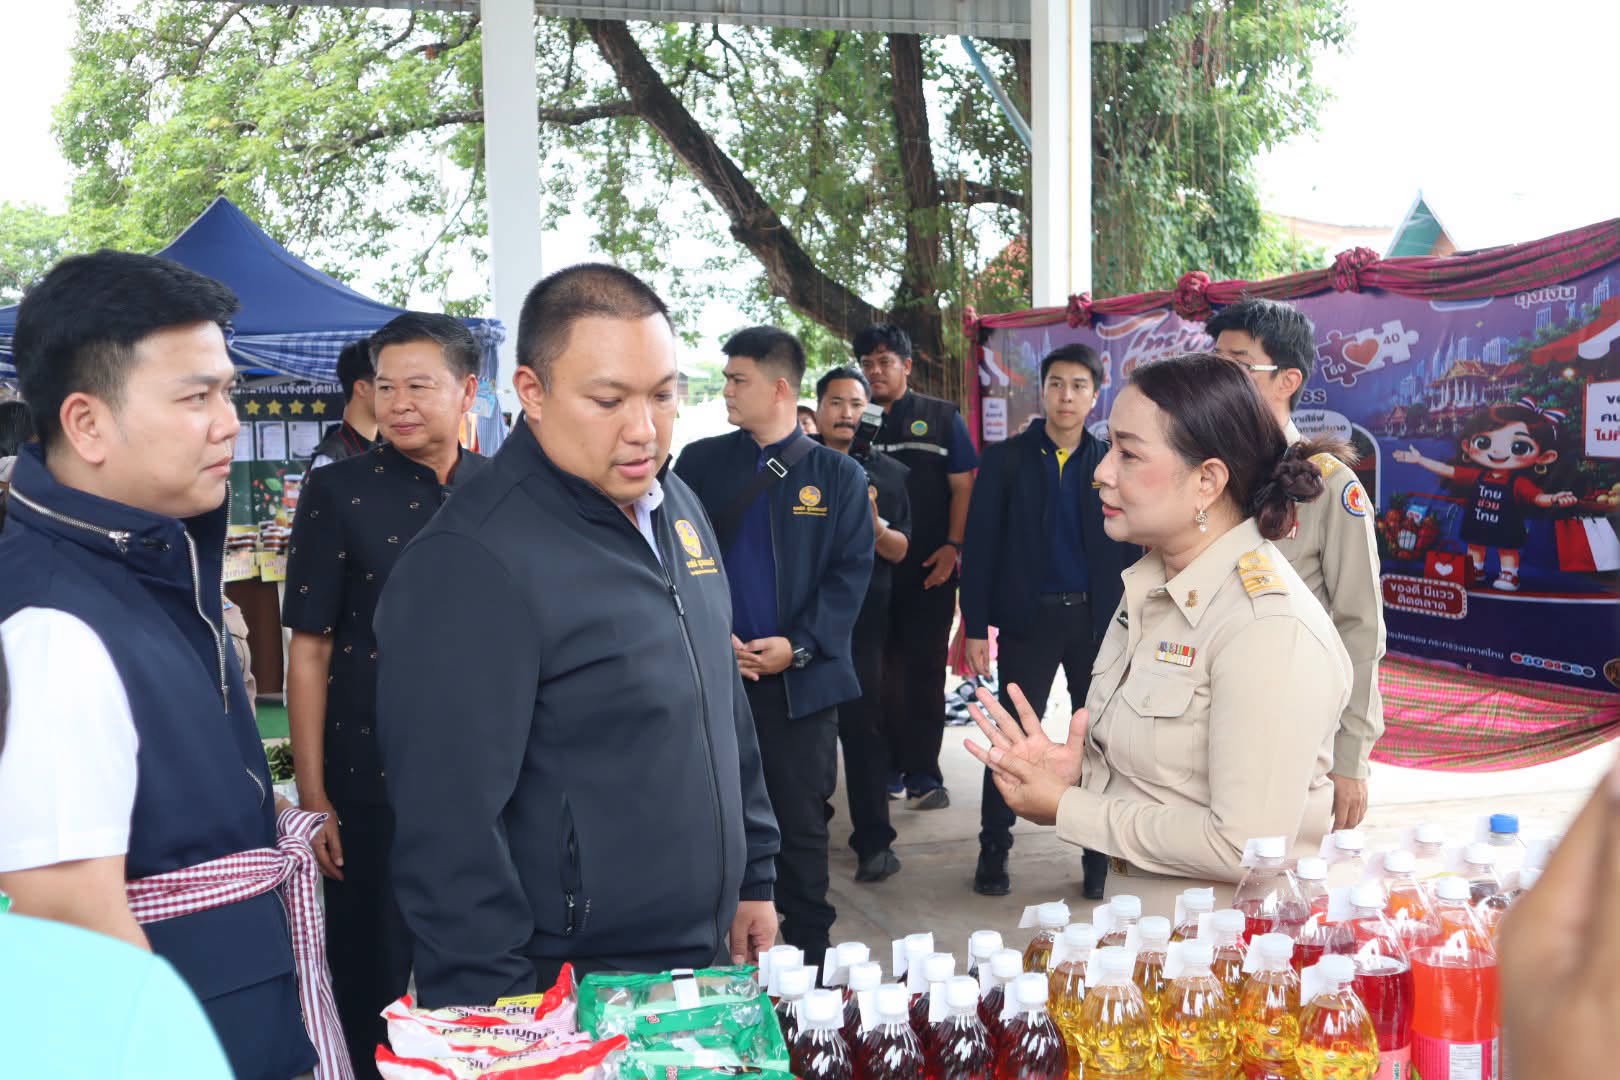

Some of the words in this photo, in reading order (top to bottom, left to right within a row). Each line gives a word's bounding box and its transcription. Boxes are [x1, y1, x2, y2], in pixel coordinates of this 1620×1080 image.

[1514, 286, 1576, 309] ถุงเงน
[1383, 333, 1400, 345] 40
[1479, 485, 1502, 499] ไทย
[1474, 508, 1499, 523] ไทย
[1390, 581, 1420, 595] ของดี
[1424, 585, 1455, 600] มีแวว
[1397, 594, 1447, 611] ติดตลาด
